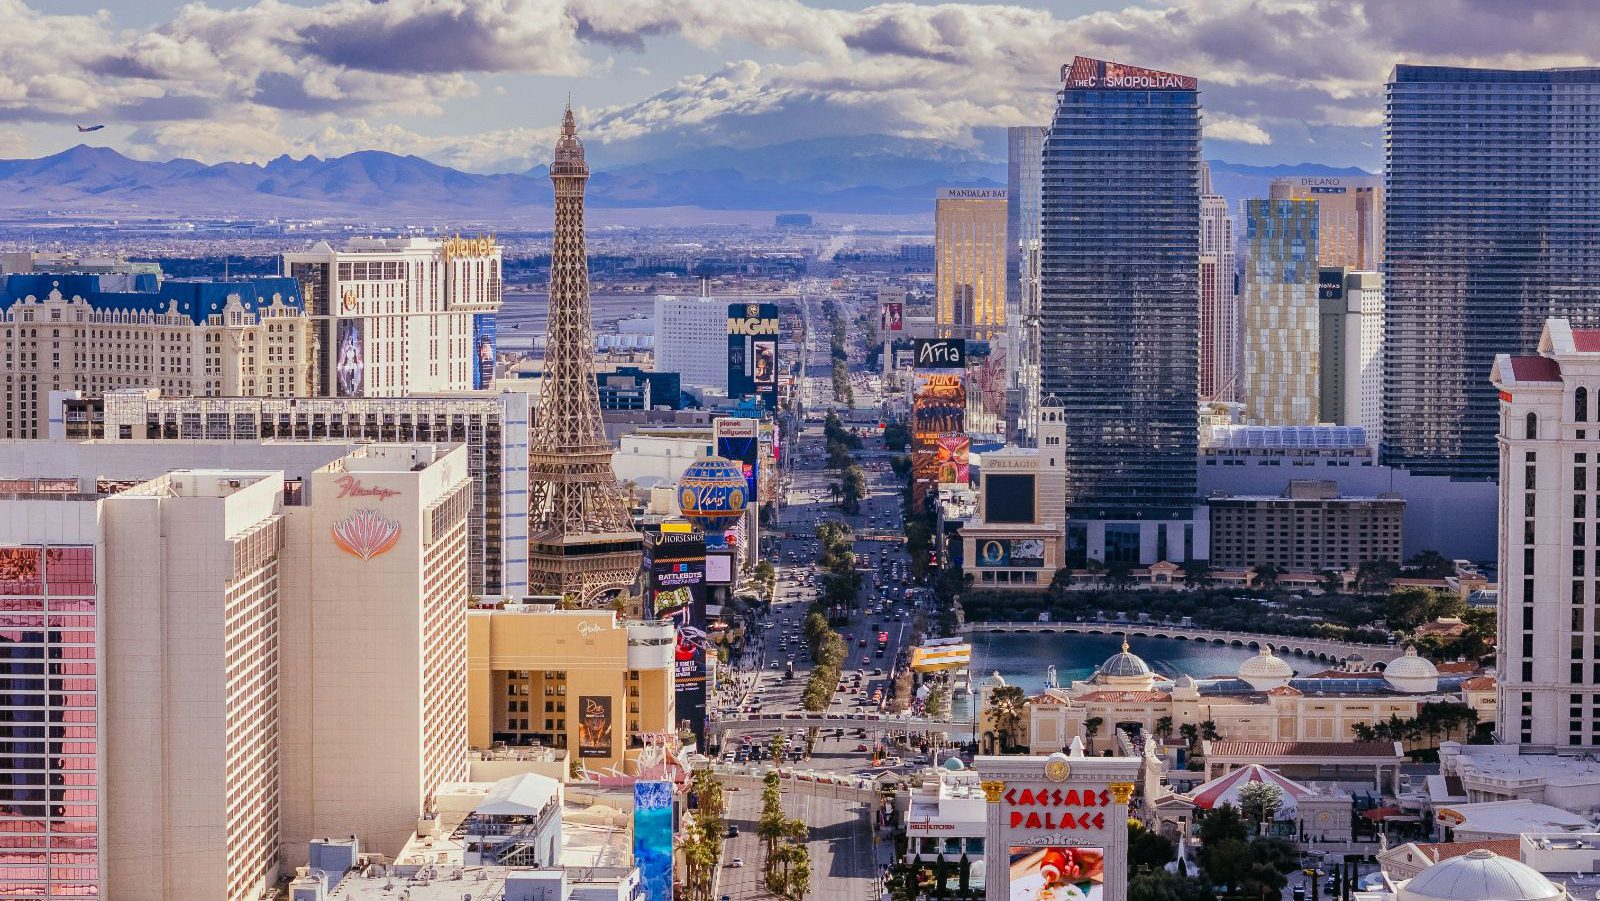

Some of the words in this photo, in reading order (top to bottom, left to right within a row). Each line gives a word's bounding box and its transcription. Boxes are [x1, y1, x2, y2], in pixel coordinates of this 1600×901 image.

[1088, 76, 1183, 88] CSMOPOLITAN
[948, 189, 990, 197] MANDALAY
[444, 232, 496, 263] planet
[727, 317, 780, 336] MGM
[919, 342, 960, 363] Aria
[719, 420, 741, 428] planet
[719, 429, 752, 437] hollywood
[984, 459, 1037, 469] BELLAGIO
[698, 482, 725, 514] Paris
[664, 533, 705, 544] HORSESHOE
[658, 571, 703, 581] BATTLEBOTS
[1004, 787, 1111, 808] CAESARS
[1010, 811, 1105, 830] PALACE
